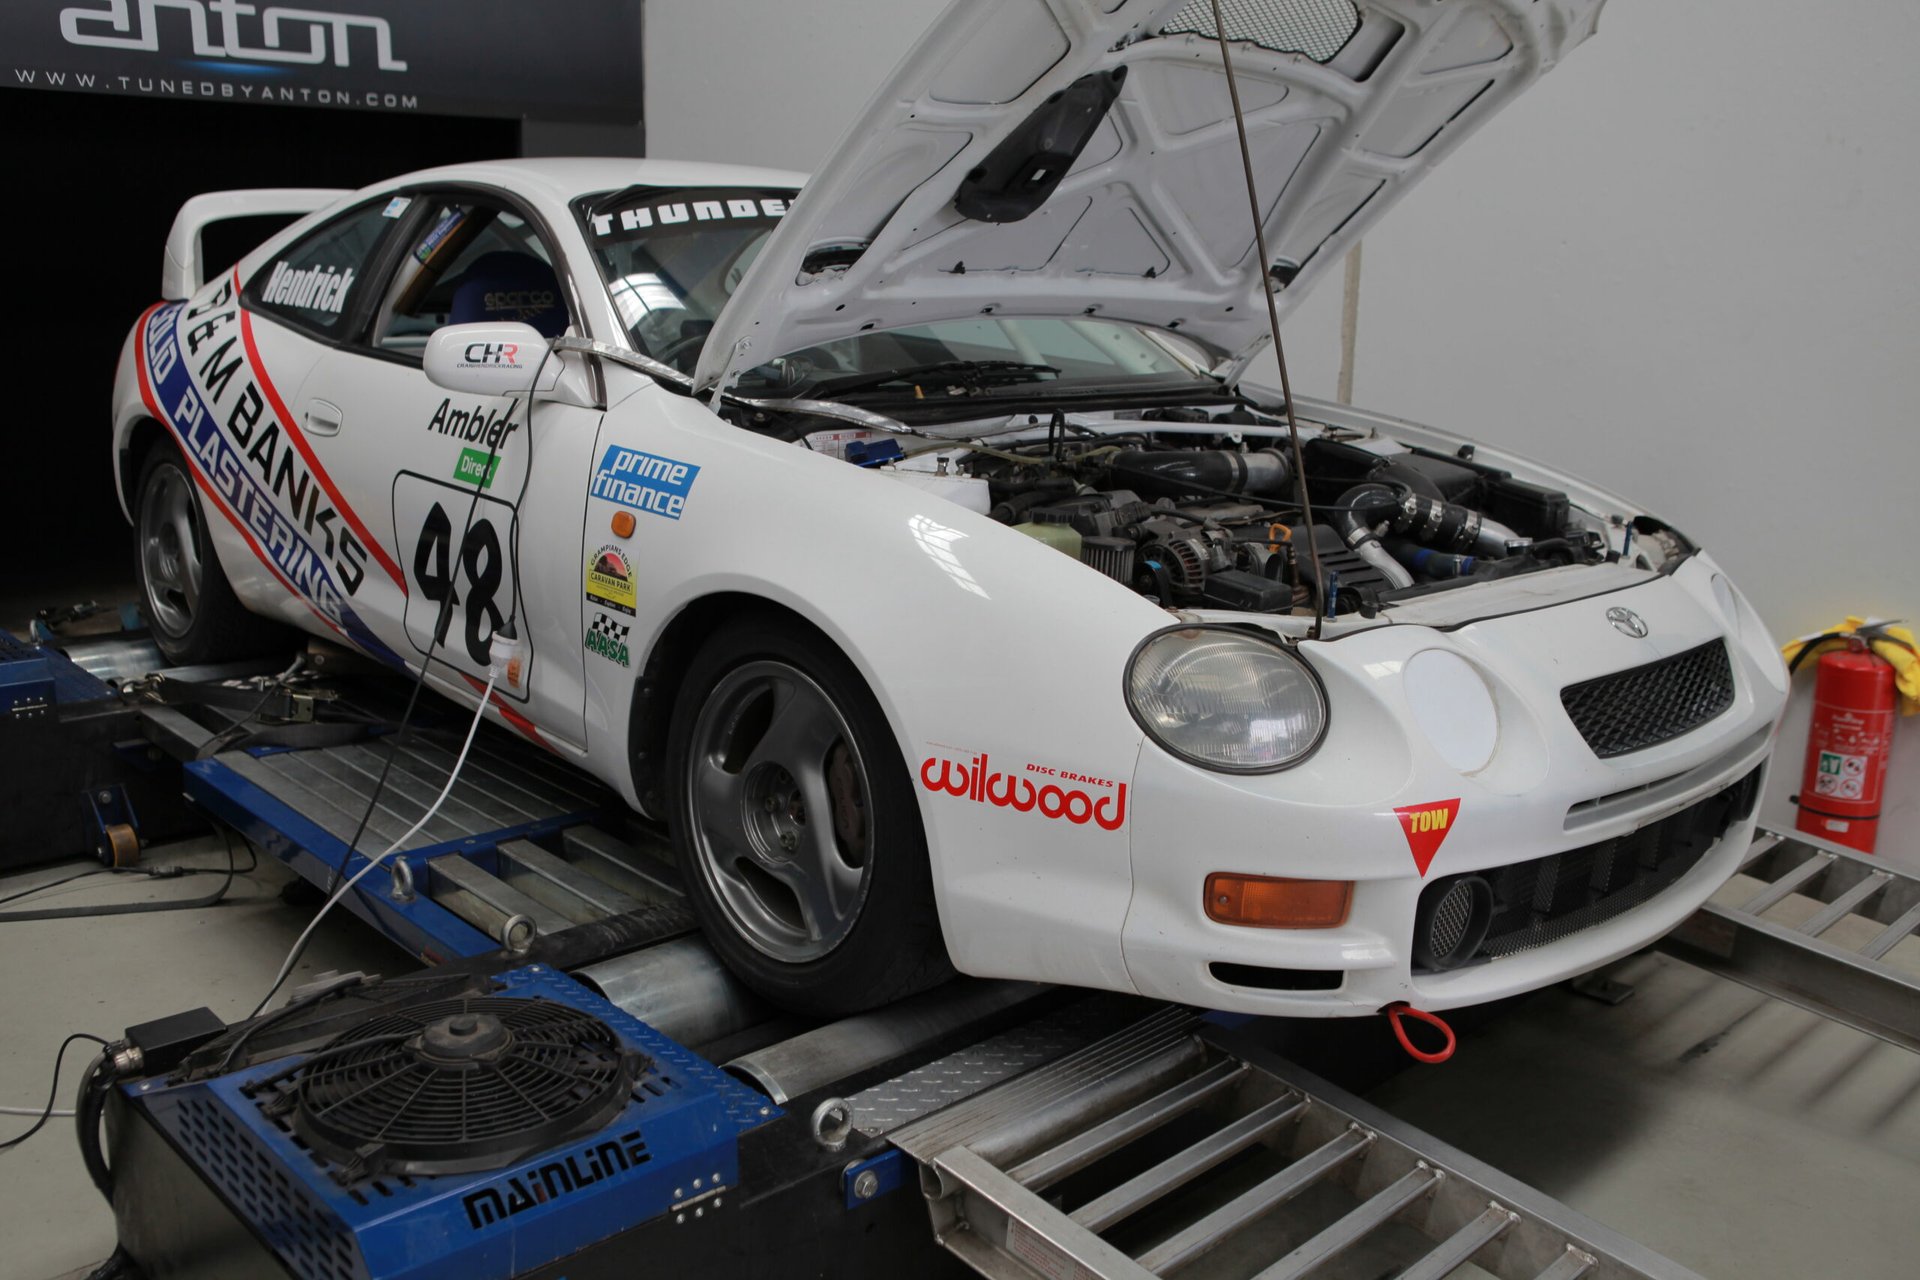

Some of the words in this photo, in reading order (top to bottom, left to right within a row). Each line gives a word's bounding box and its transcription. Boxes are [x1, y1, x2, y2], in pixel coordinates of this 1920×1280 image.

[15, 68, 418, 108] WWW.TUNEDBYANTON.COM
[591, 199, 800, 236] THUNDE
[262, 260, 354, 314] Hendrick
[464, 343, 519, 364] CHR
[427, 398, 519, 450] Ambler
[147, 303, 184, 385] SOLID
[174, 386, 345, 621] PLASTERING
[610, 450, 689, 486] prime
[227, 381, 367, 597] BANKS
[593, 469, 685, 517] finance
[590, 544, 622, 566] GRAMPIANS
[621, 552, 633, 577] EDGE
[413, 501, 504, 667] 48
[590, 572, 616, 588] CARAVAN
[616, 579, 631, 592] PARK
[584, 627, 630, 667] AASA
[920, 753, 1127, 831] wilwood
[1026, 763, 1057, 776] DISC
[1060, 770, 1114, 788] BRAKES
[1409, 808, 1449, 834] TOW
